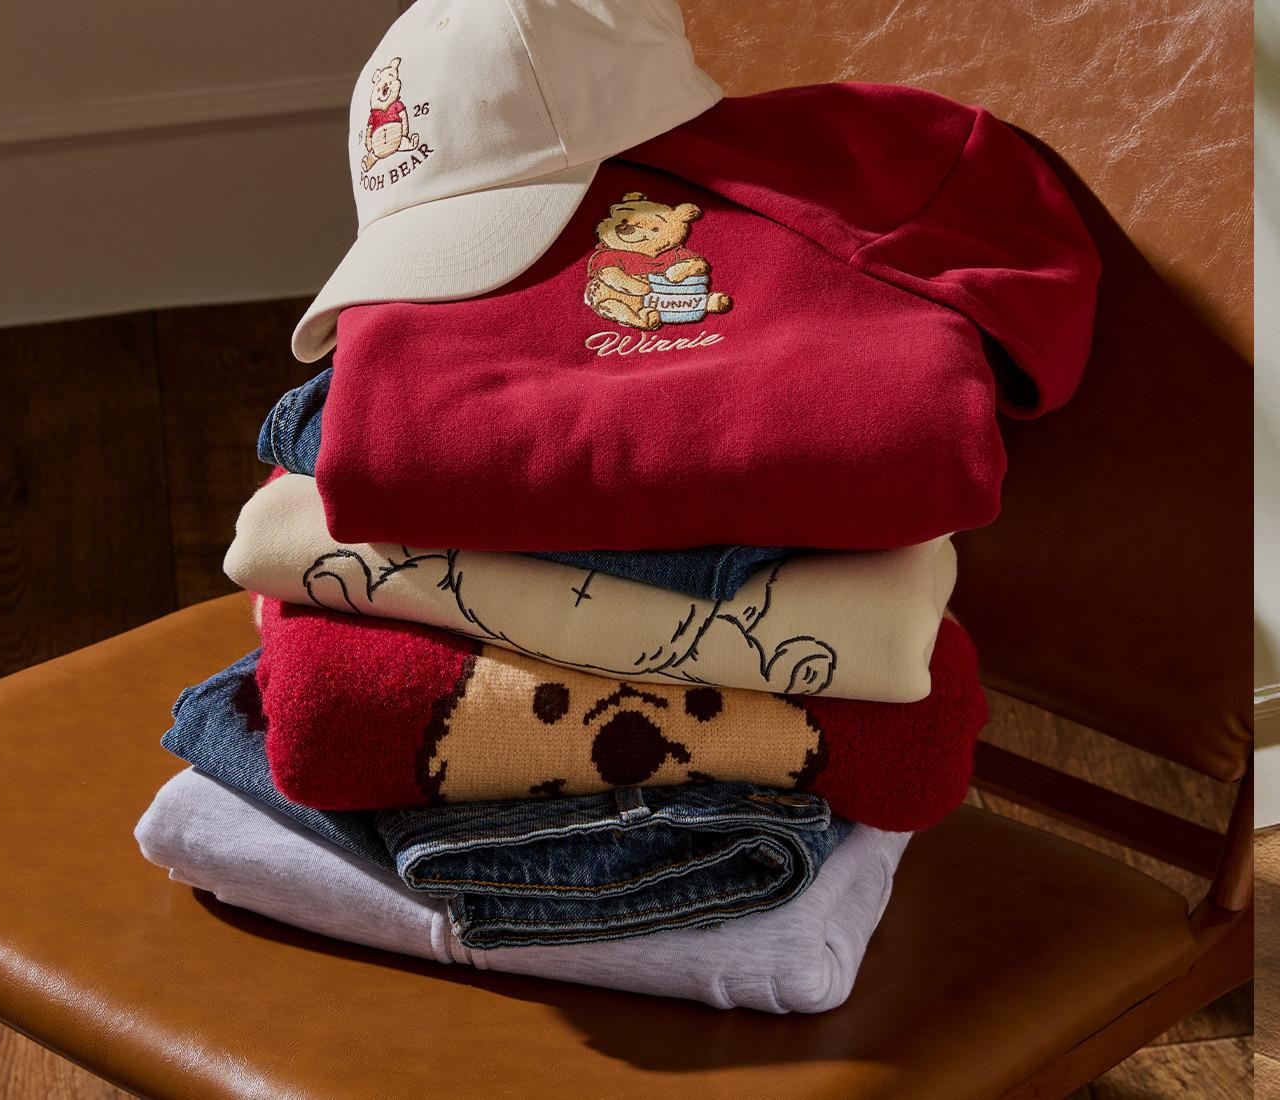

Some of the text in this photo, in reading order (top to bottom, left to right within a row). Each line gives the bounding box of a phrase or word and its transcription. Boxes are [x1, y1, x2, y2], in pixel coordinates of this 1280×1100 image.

[413, 102, 430, 118] 26
[388, 143, 435, 185] BEAR
[585, 330, 725, 357] Winnie
